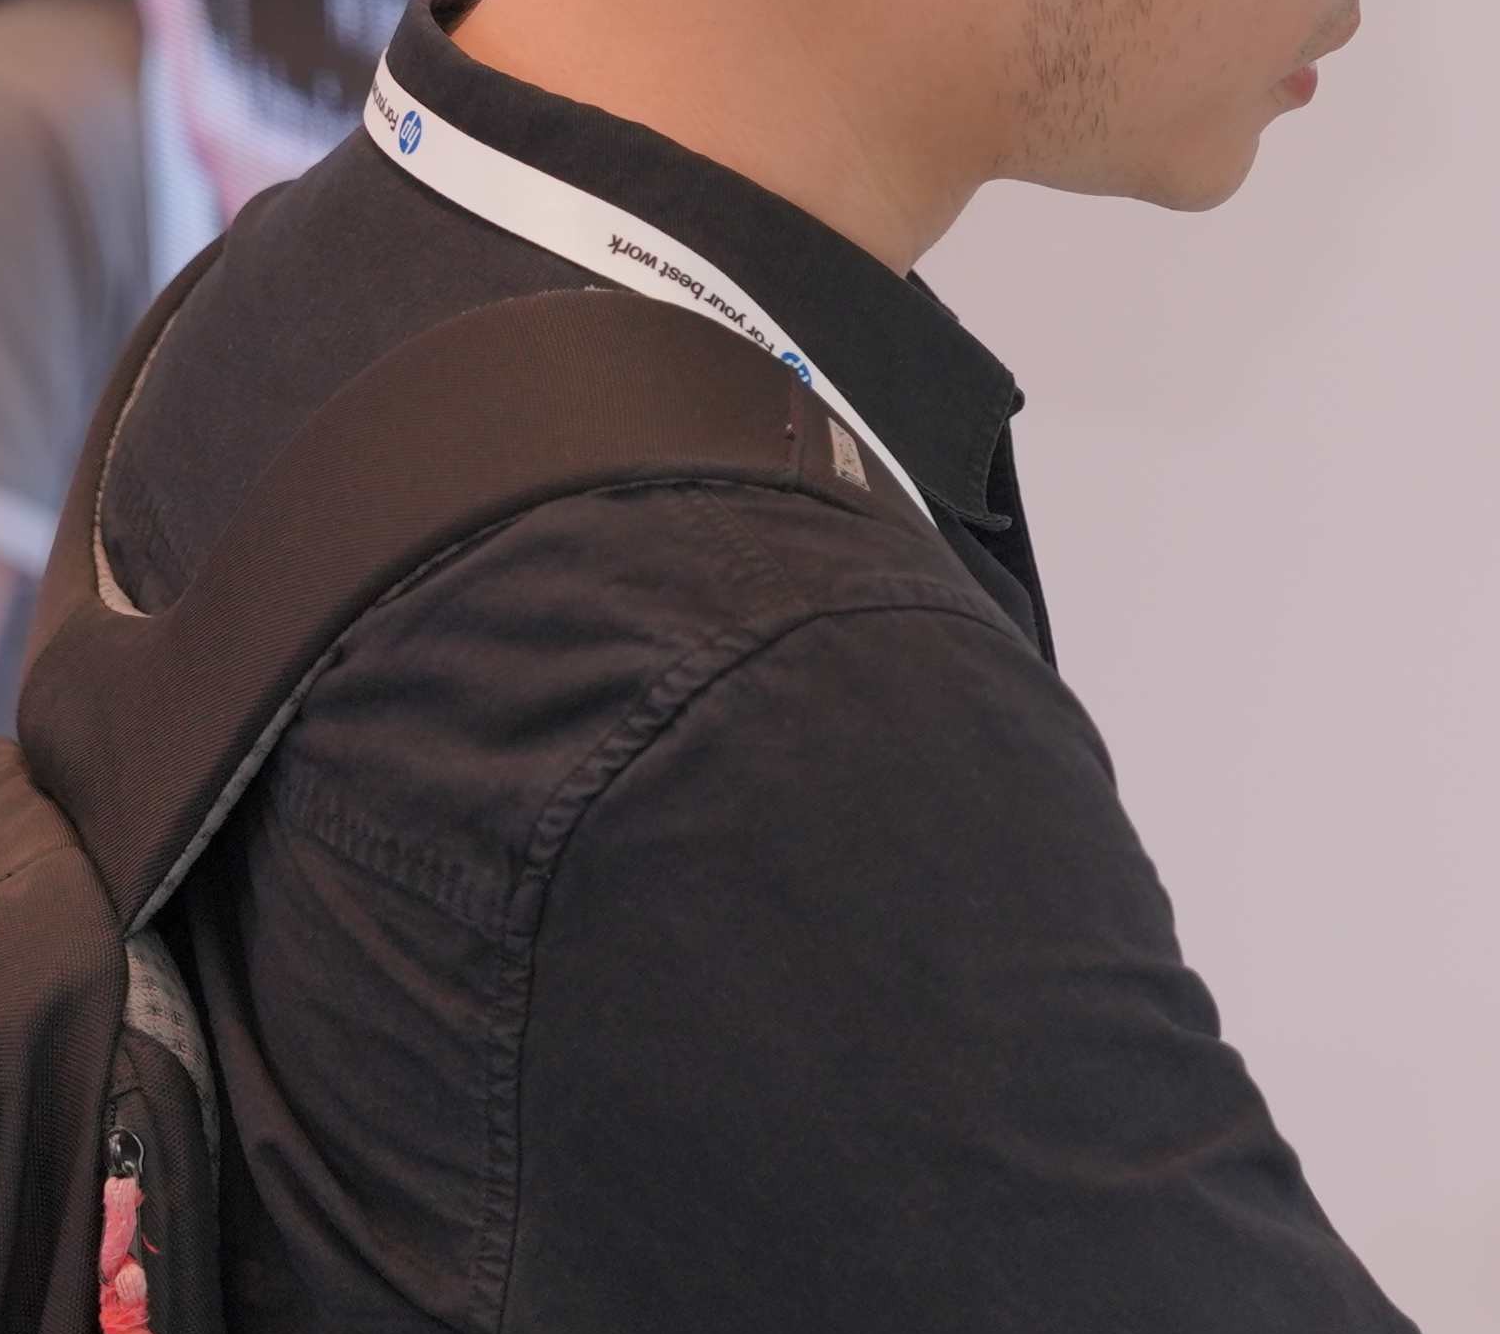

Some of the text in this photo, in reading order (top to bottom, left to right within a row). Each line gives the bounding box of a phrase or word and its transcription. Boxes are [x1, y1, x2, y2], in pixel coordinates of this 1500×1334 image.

[607, 234, 775, 354] For your best work
